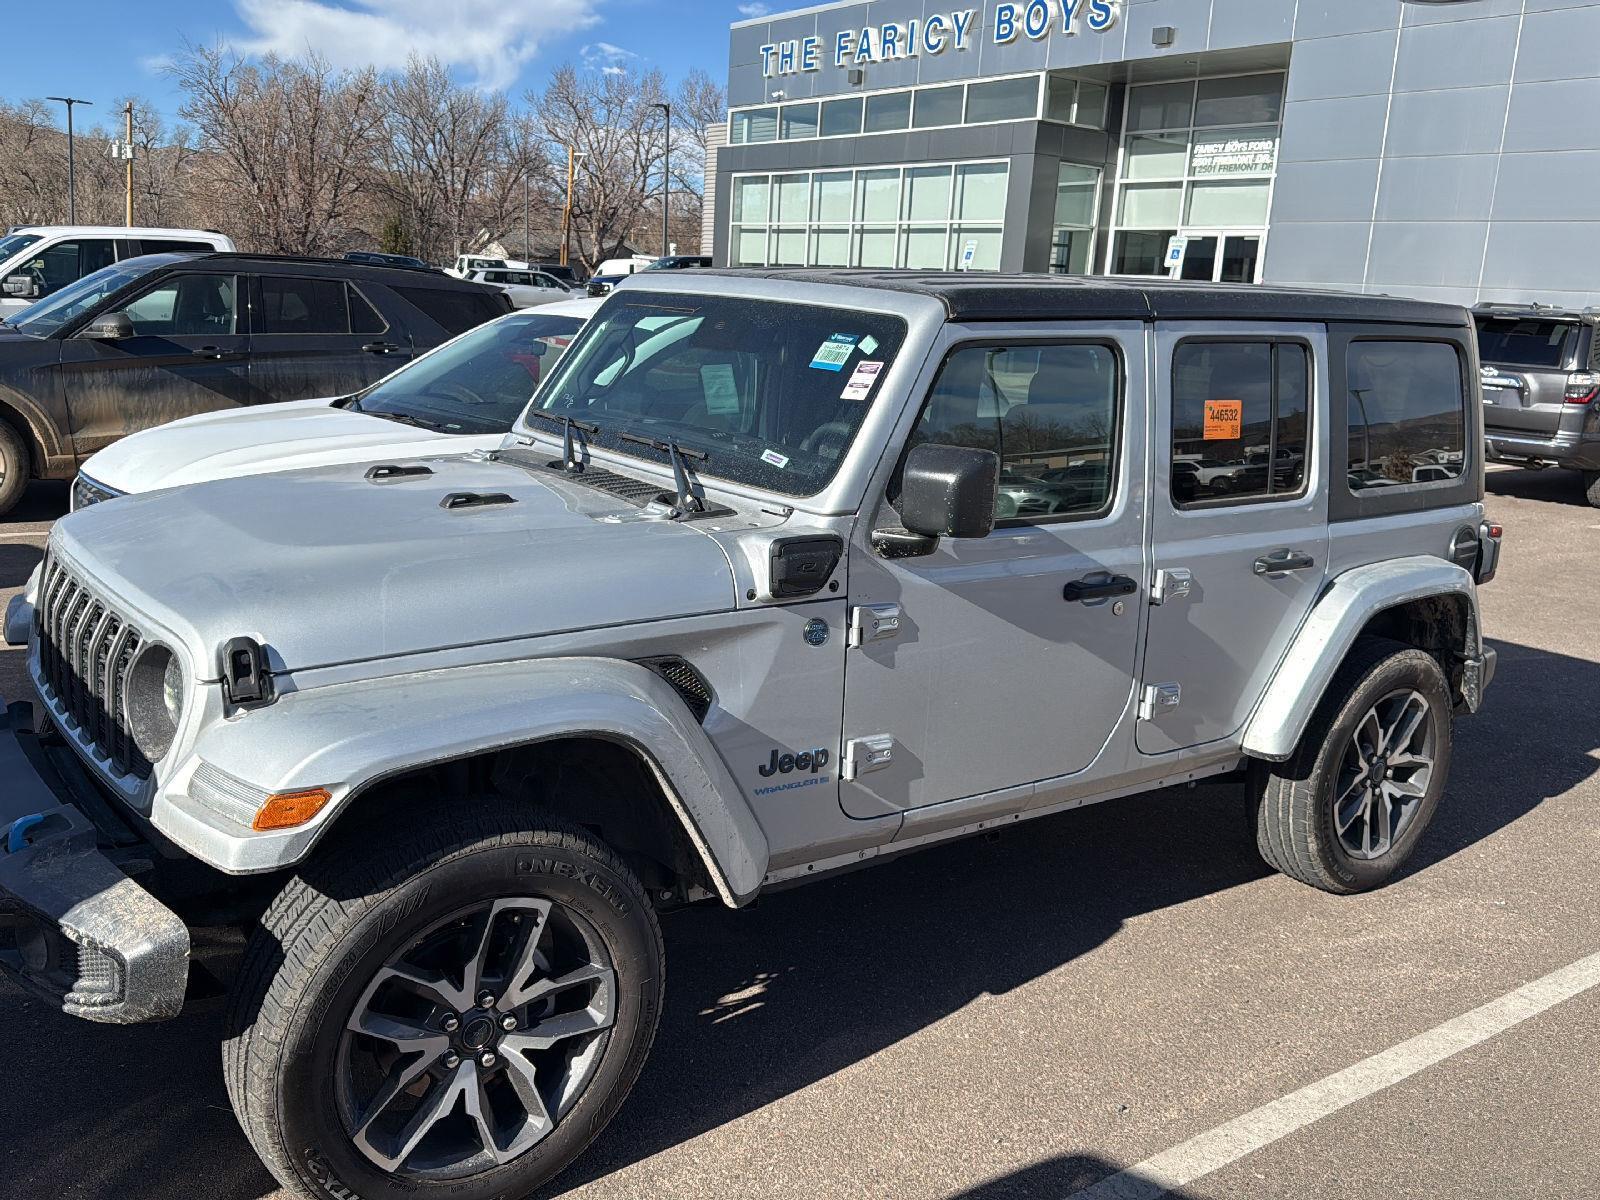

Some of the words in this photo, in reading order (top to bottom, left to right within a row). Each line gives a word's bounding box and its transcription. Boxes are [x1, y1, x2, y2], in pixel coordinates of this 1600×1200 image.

[760, 37, 818, 77] THE
[834, 9, 975, 67] FARICY
[994, 0, 1116, 43] BOYS
[1225, 141, 1248, 152] BOYS
[1248, 140, 1273, 150] FORD
[1213, 154, 1254, 165] FREMONT
[1218, 163, 1259, 173] FREMONT
[1210, 408, 1238, 422] 446532
[758, 747, 829, 777] Jeep
[754, 777, 818, 796] WRANGLER
[530, 858, 622, 910] NEXEN
